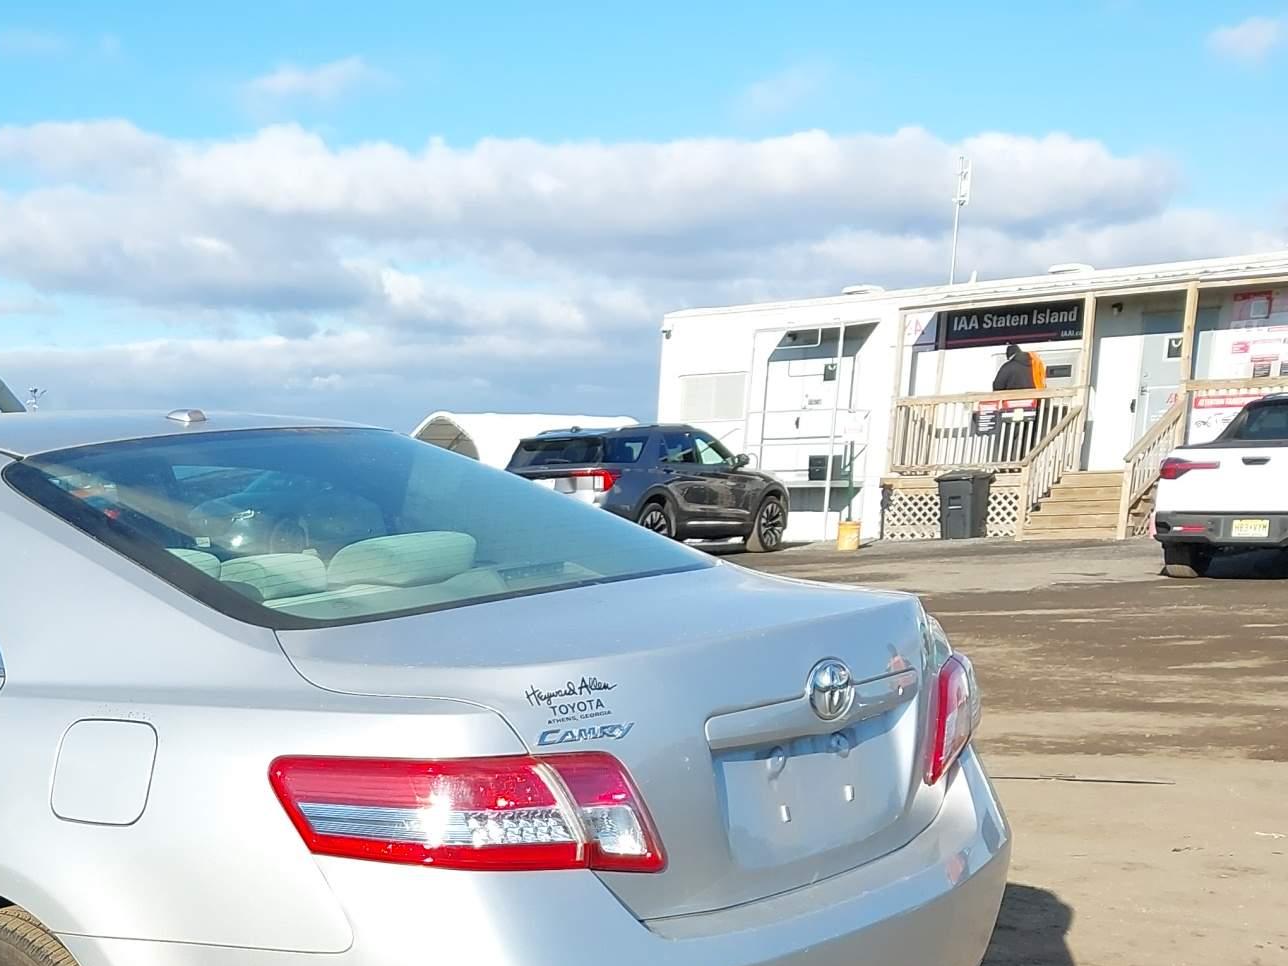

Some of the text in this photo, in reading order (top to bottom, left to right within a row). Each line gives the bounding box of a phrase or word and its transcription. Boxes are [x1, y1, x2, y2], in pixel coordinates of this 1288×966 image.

[953, 306, 1079, 331] IAA Staten Island
[525, 676, 617, 707] Heyward Allen
[550, 698, 605, 717] TOYOTA
[579, 709, 612, 720] GEORGIA
[537, 722, 636, 747] CAMRY
